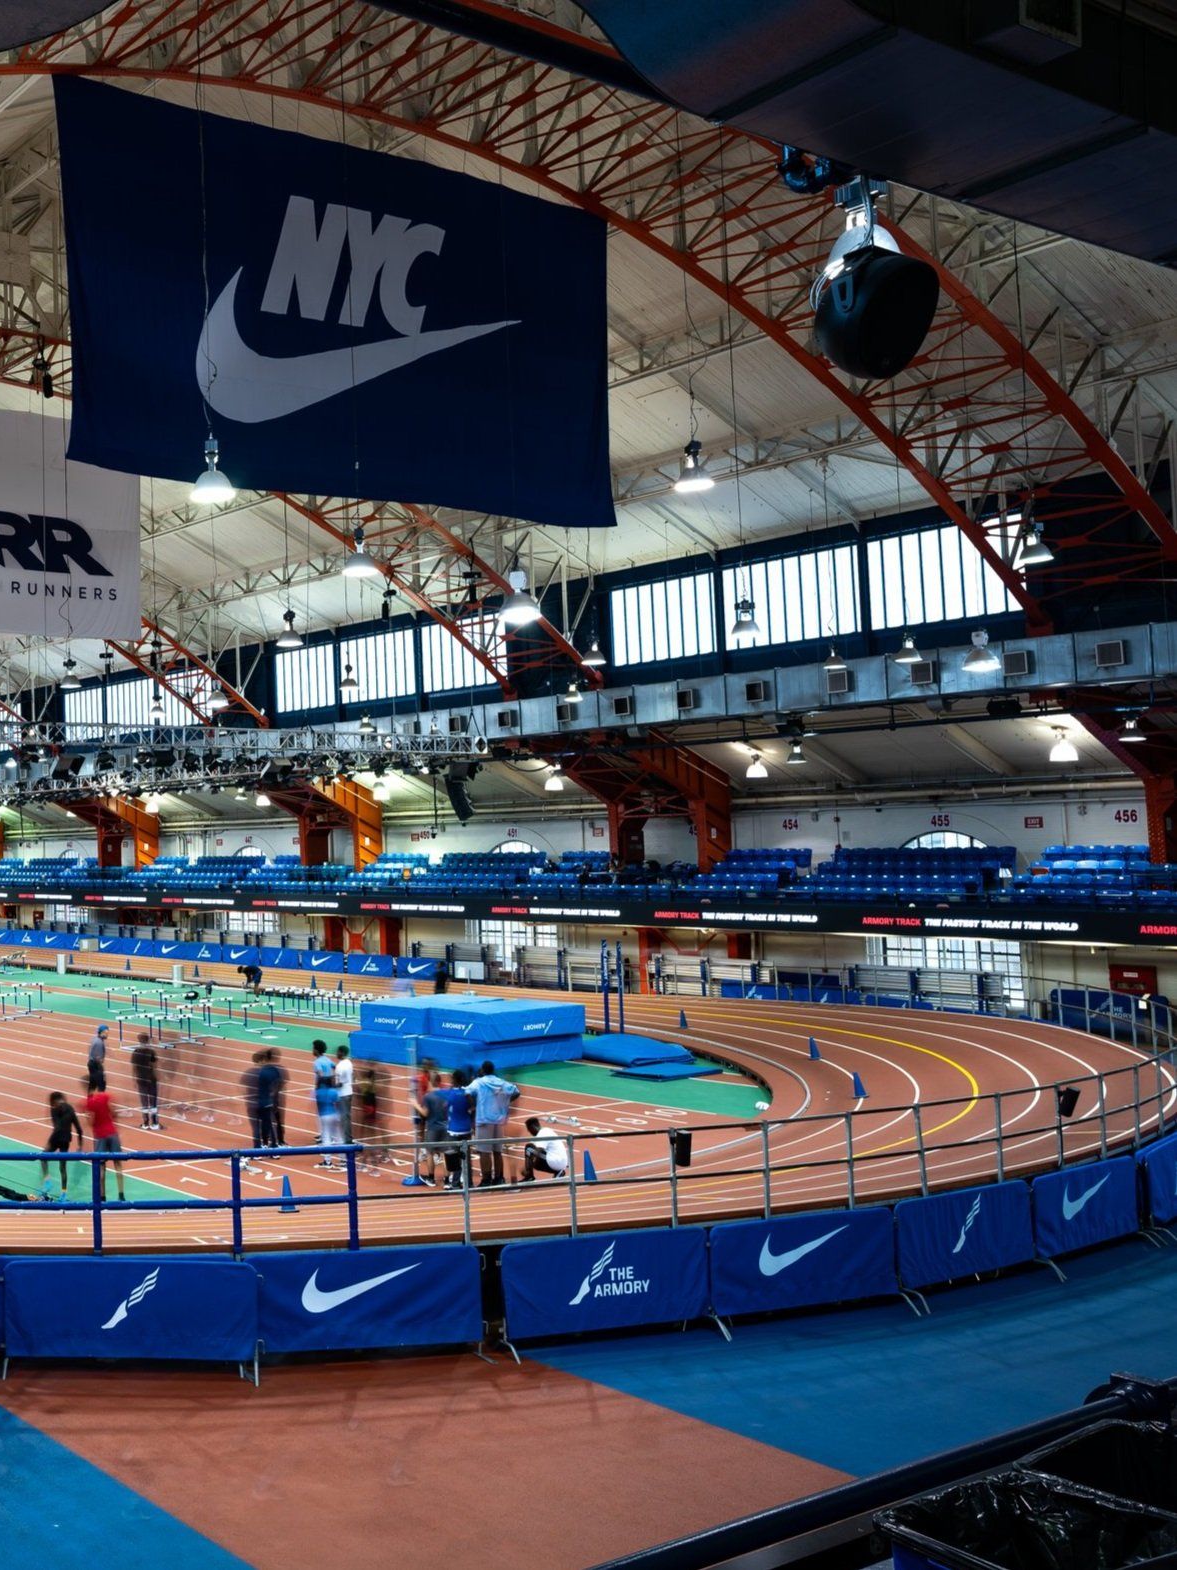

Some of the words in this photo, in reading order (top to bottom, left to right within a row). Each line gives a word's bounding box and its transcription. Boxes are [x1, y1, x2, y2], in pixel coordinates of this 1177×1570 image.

[260, 195, 446, 337] NYC
[11, 581, 118, 602] RUNNERS
[931, 814, 950, 827] 455
[1114, 809, 1138, 823] 456
[688, 825, 698, 836] 45
[782, 819, 799, 831] 454
[896, 918, 920, 926] TRACK
[925, 918, 941, 926] THE
[943, 919, 979, 928] FASTEST
[982, 920, 1010, 929] TRACK
[1024, 922, 1042, 930] THE
[1044, 922, 1078, 931] WORLD
[1140, 925, 1177, 935] ARMOR
[609, 1266, 634, 1281] THE
[594, 1279, 650, 1298] ARMORY
